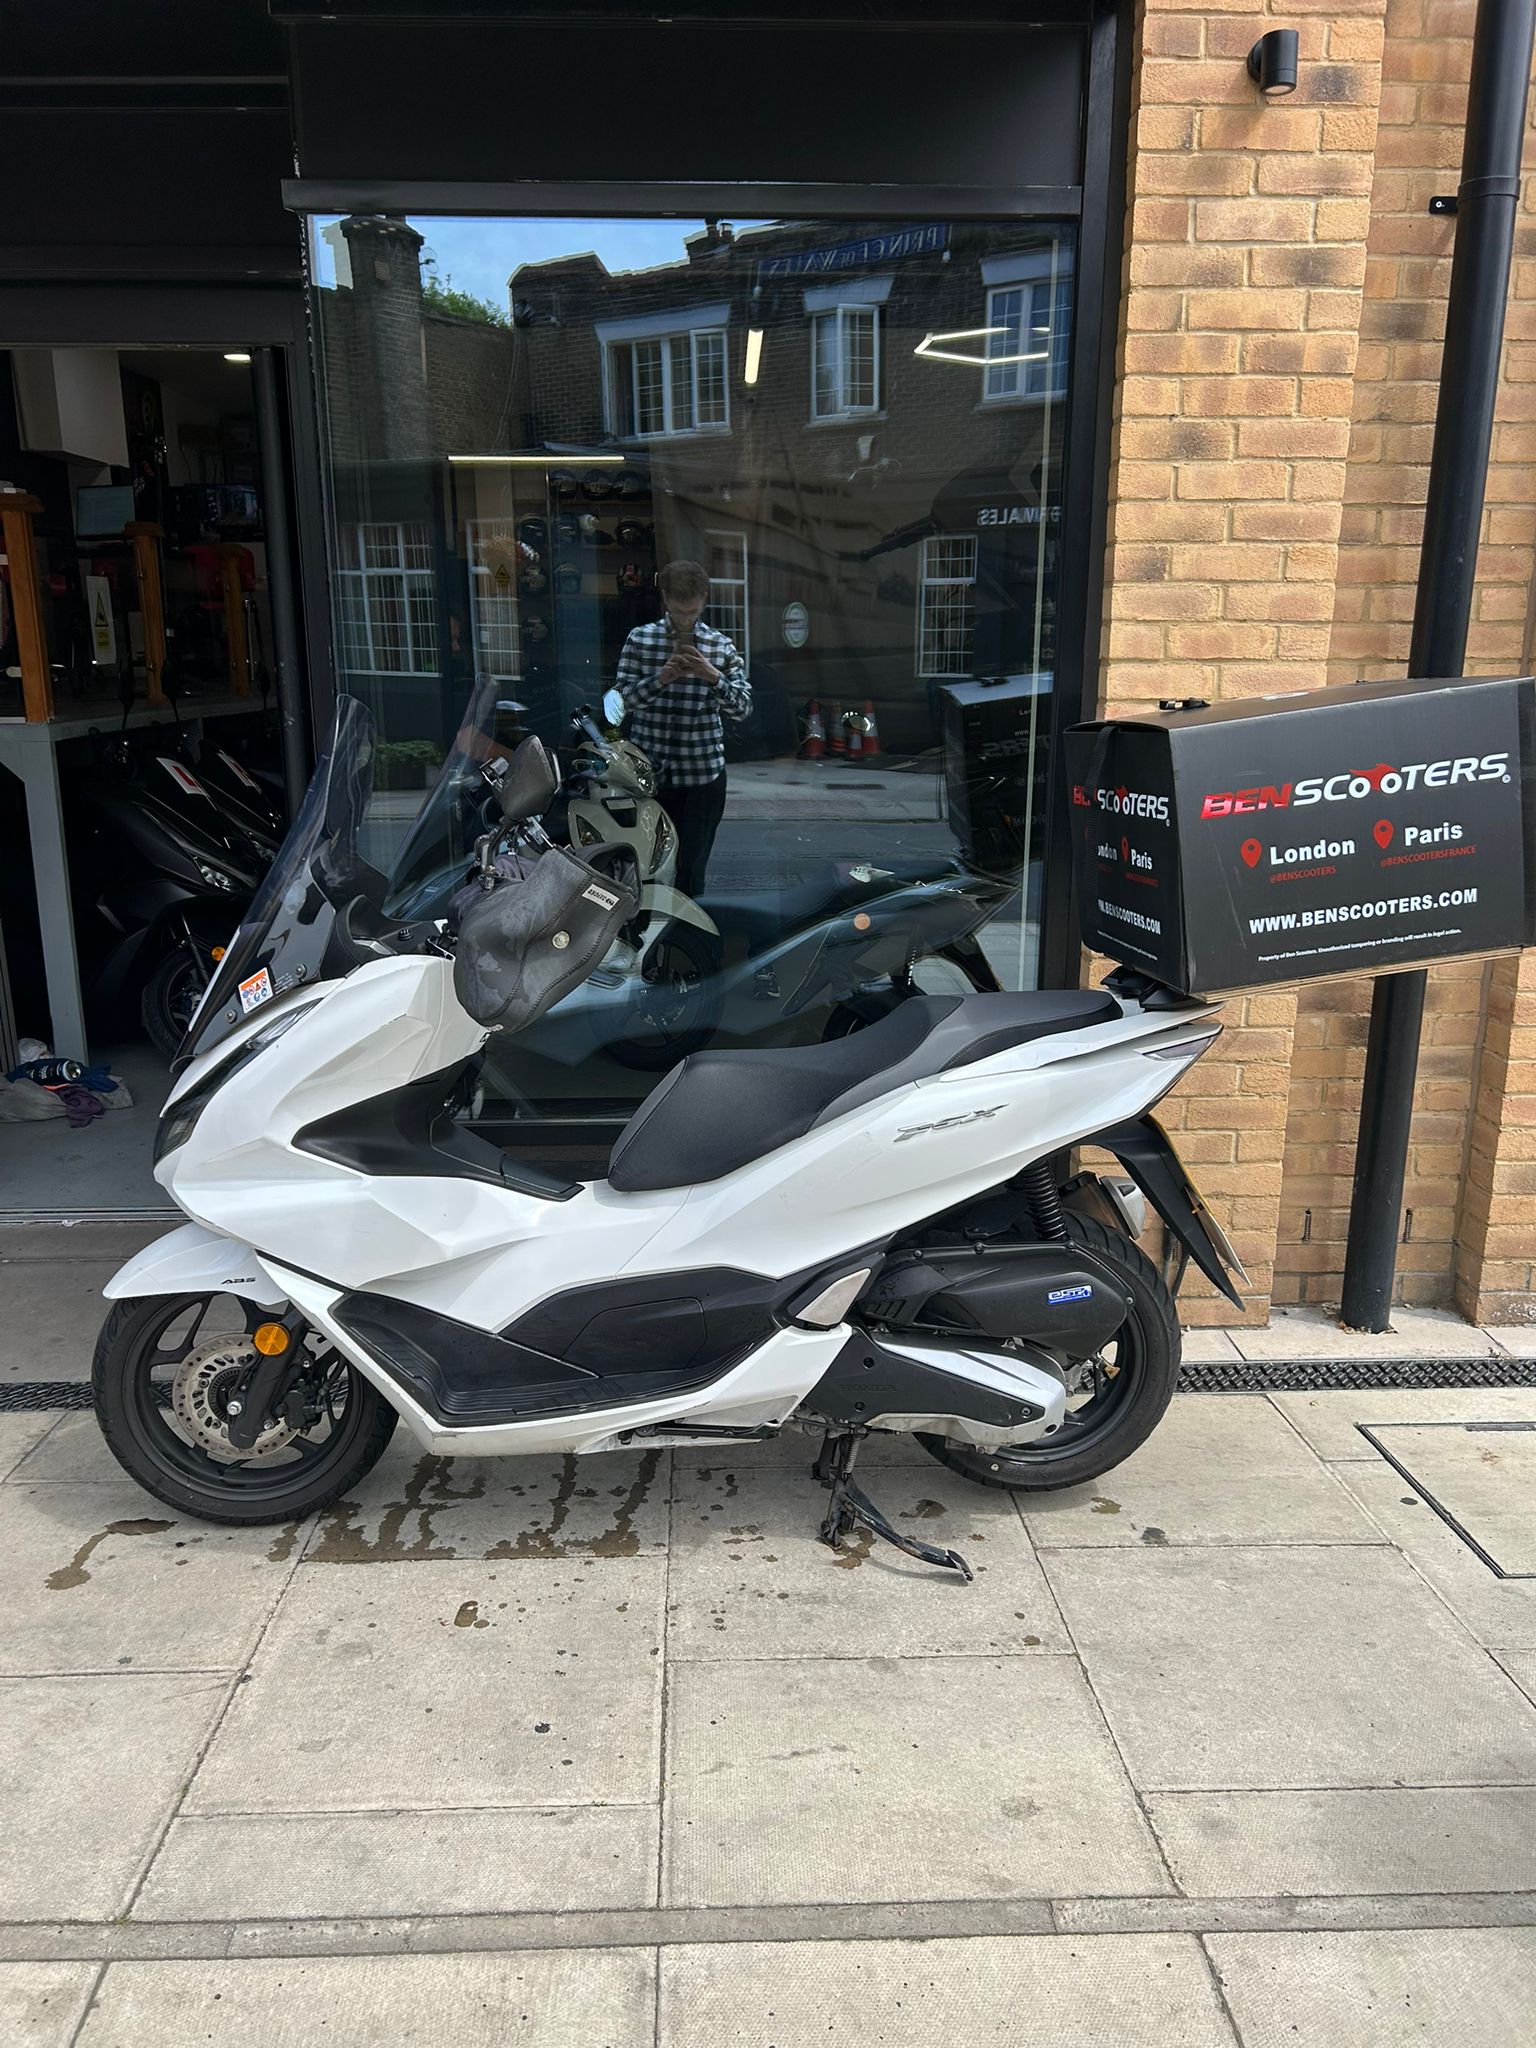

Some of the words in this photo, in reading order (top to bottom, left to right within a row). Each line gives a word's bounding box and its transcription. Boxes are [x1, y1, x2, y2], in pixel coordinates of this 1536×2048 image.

[1404, 822, 1463, 847] Paris
[1131, 848, 1153, 870] Paris
[1269, 838, 1355, 866] London
[1380, 844, 1478, 869] @BENSCOOTERSFRANCE
[1269, 865, 1337, 884] @BENSCOOTERS
[1249, 888, 1478, 934] WWW.BENSCOOTERS.COM
[892, 1102, 1010, 1143] PCX
[220, 1276, 257, 1285] ABS
